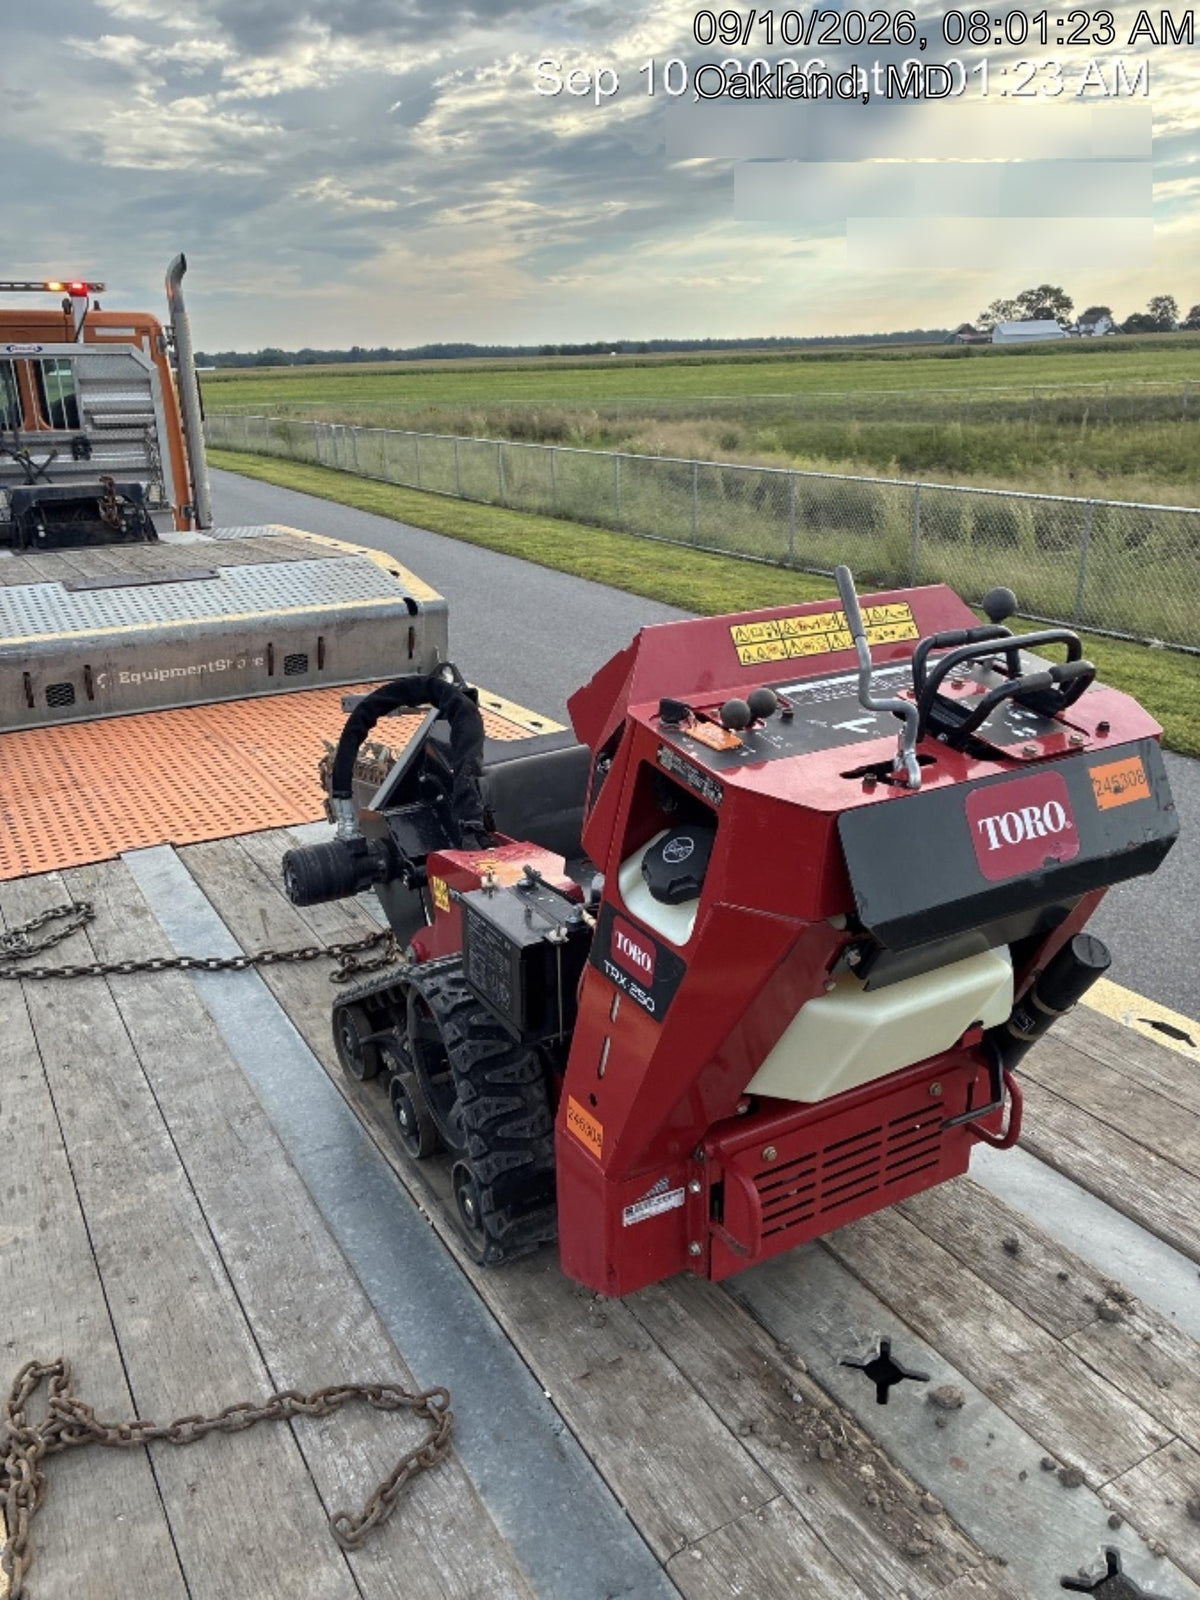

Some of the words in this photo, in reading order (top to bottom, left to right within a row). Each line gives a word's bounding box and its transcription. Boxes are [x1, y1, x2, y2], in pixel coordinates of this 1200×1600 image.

[118, 656, 265, 686] EquipmentShae
[977, 800, 1067, 851] TORO
[615, 930, 653, 973] TORO
